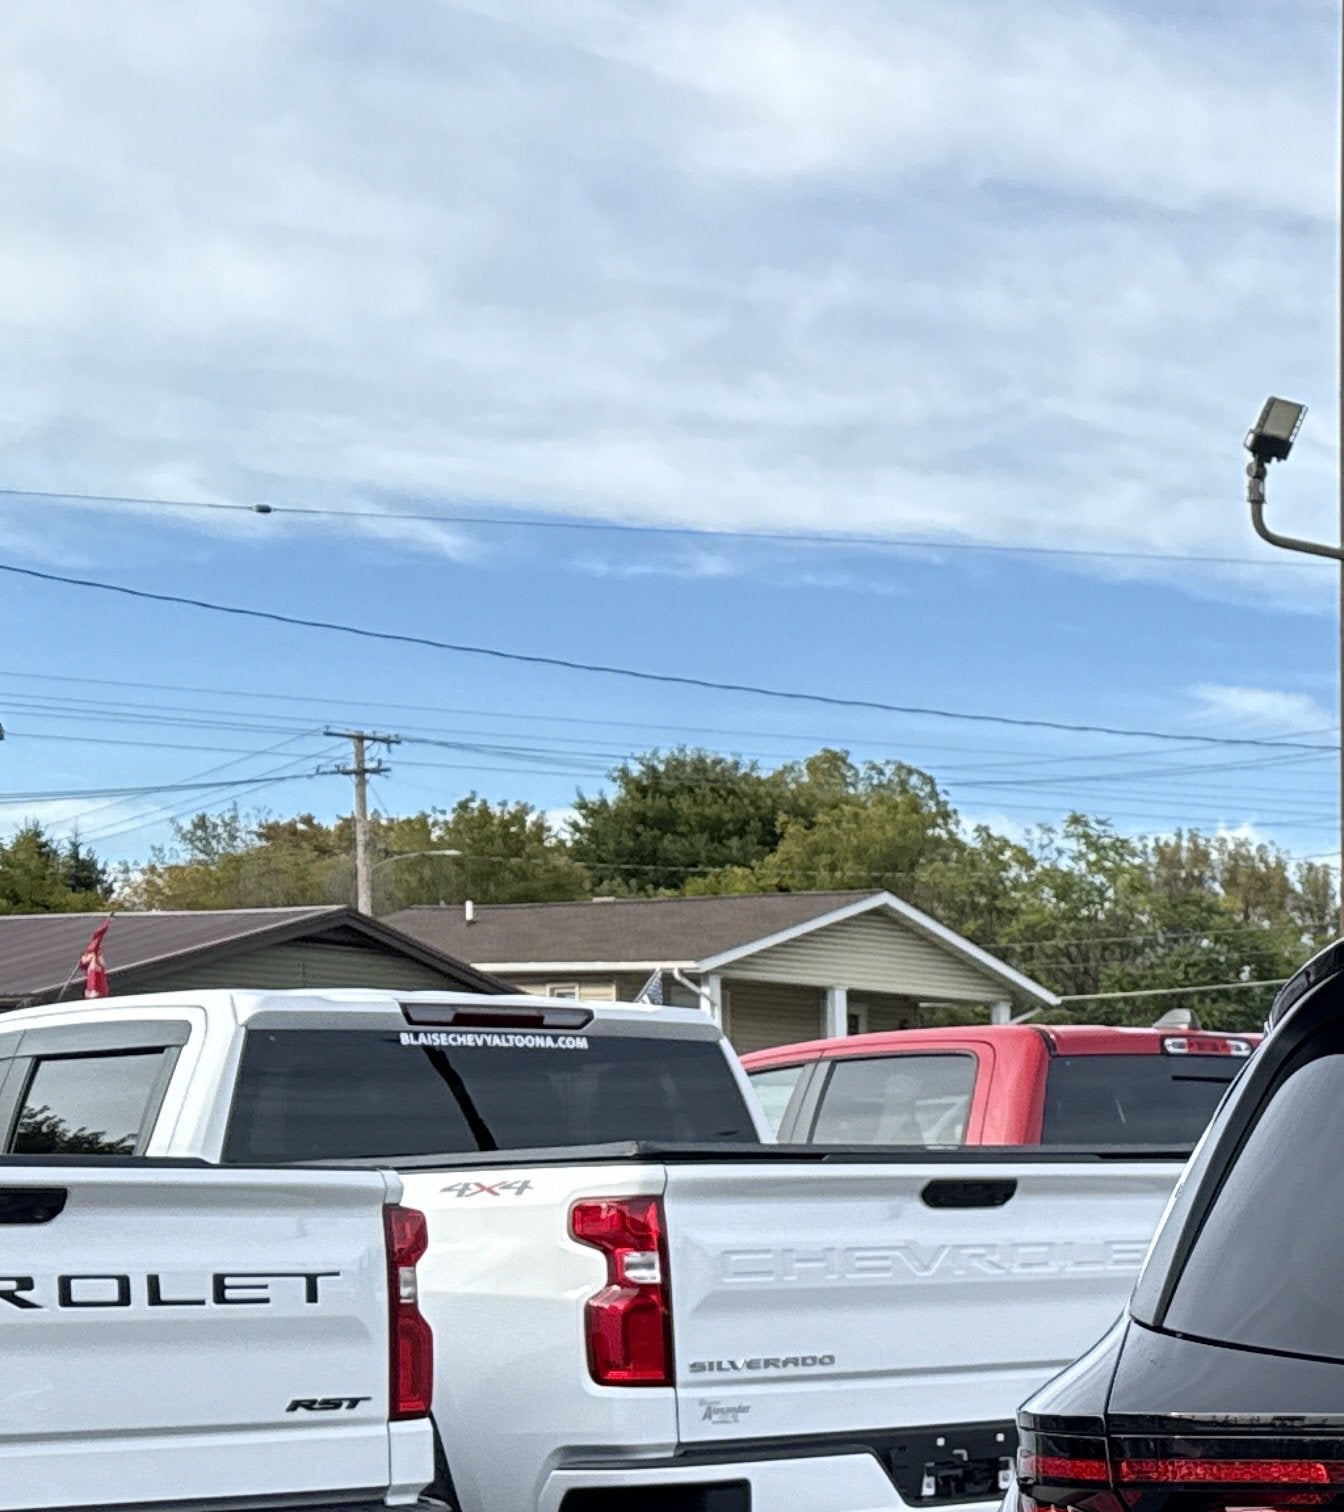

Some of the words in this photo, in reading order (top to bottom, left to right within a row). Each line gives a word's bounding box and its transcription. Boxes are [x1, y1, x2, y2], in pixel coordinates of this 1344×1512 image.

[400, 1032, 589, 1050] BLAISECHEVYALTOONA.COM
[440, 1179, 533, 1198] 4X4
[721, 1239, 1153, 1283] CHEVROLE
[689, 1354, 836, 1373] SILVERADO
[285, 1396, 373, 1413] RST
